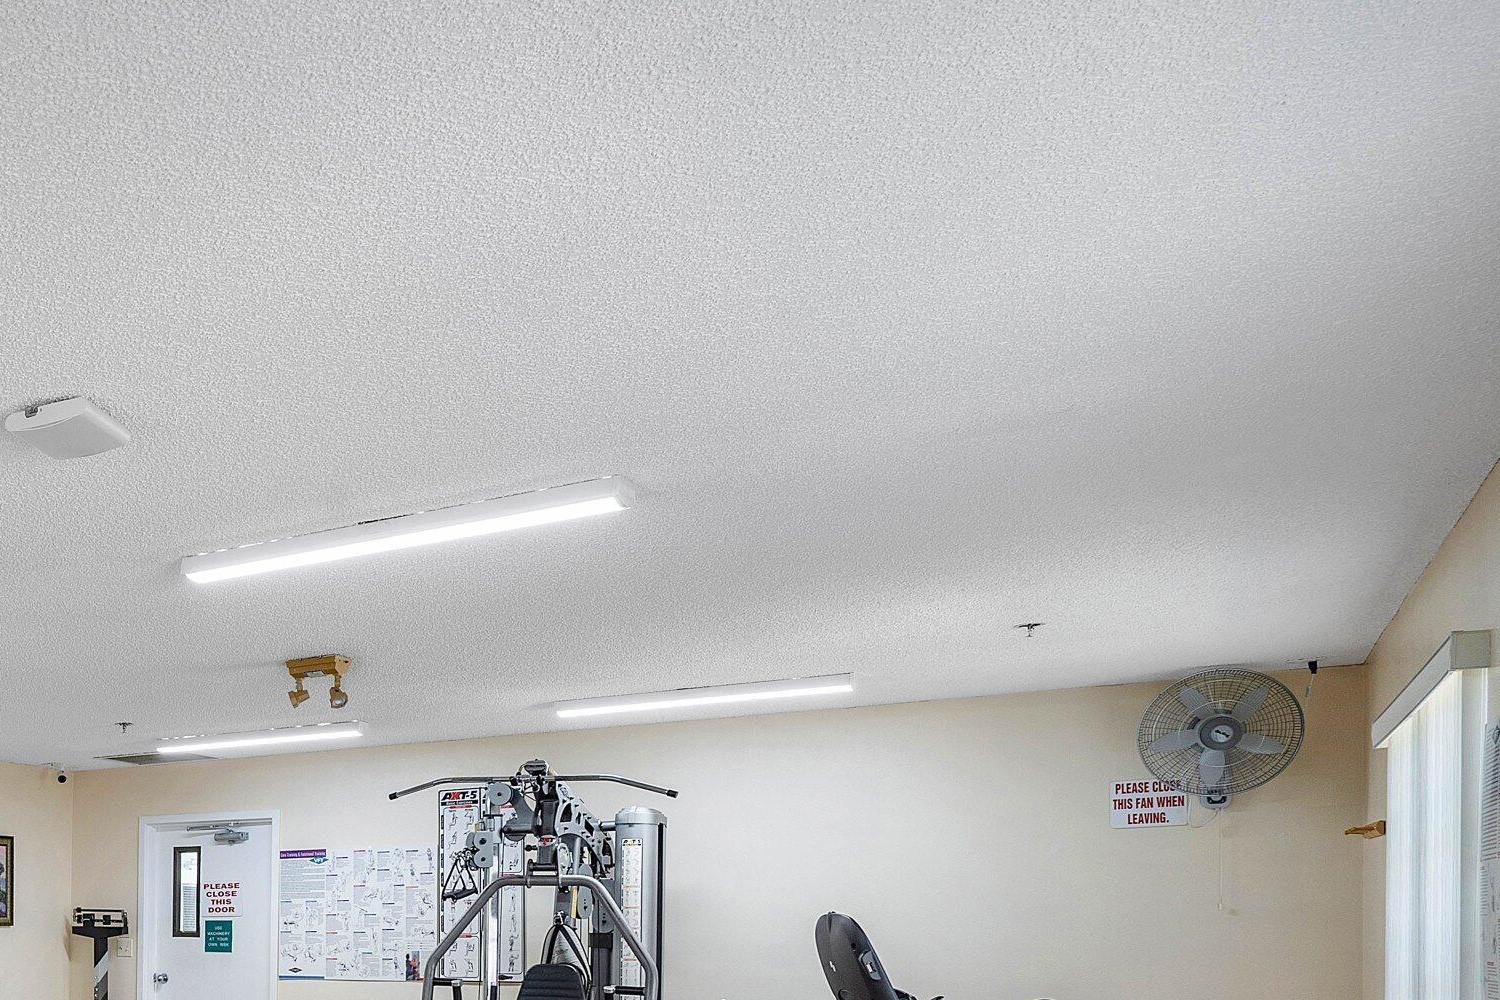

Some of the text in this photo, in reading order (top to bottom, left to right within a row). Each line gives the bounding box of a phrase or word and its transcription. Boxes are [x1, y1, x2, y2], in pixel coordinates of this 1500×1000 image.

[1115, 782, 1149, 794] PLEASE
[441, 791, 477, 800] AXT-5
[1112, 795, 1185, 810] THIS FAN WHEN
[1127, 812, 1169, 824] LEAVING.
